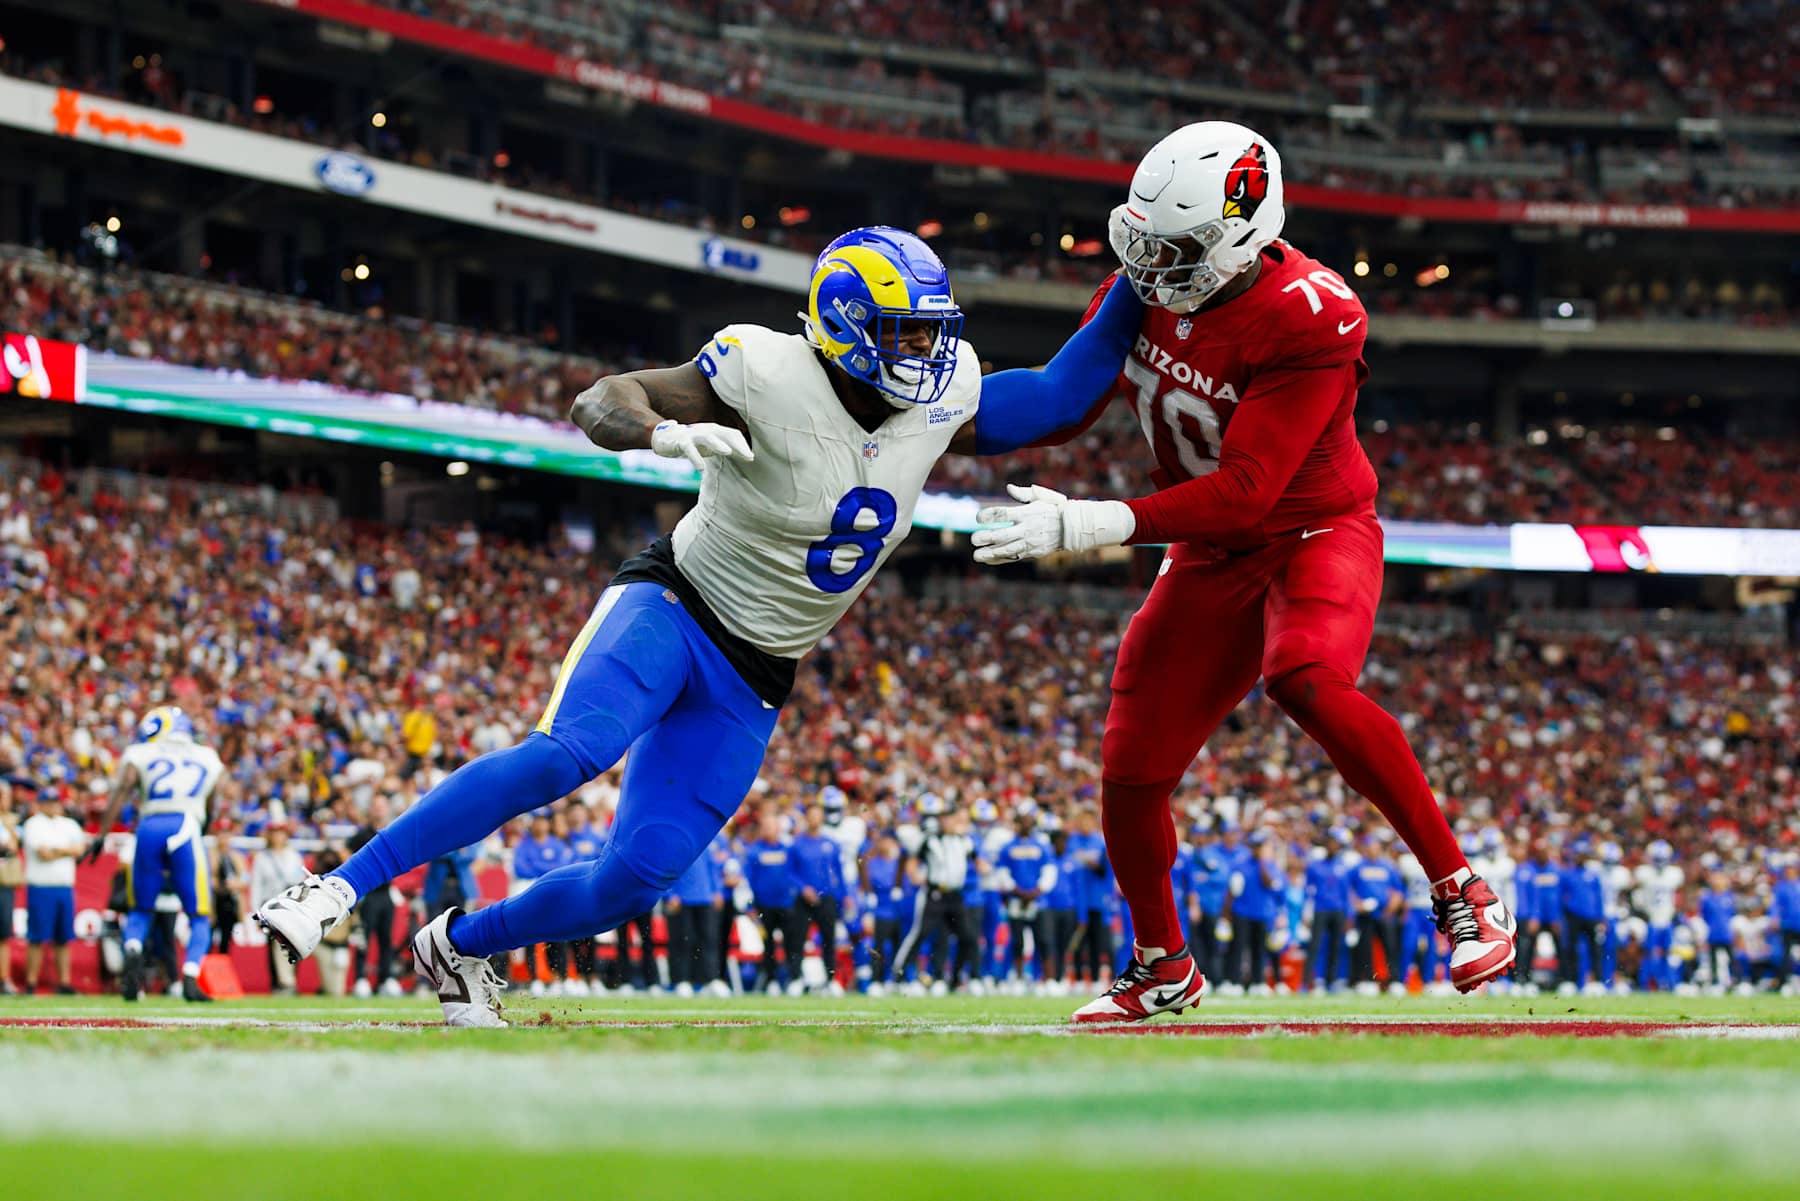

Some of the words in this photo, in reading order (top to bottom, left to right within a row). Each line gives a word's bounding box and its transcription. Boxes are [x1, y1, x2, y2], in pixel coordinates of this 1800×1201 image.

[1281, 270, 1354, 315] 70
[1134, 333, 1239, 403] RIZONA
[1123, 355, 1221, 478] 70
[805, 486, 898, 594] 8
[147, 758, 208, 801] 27
